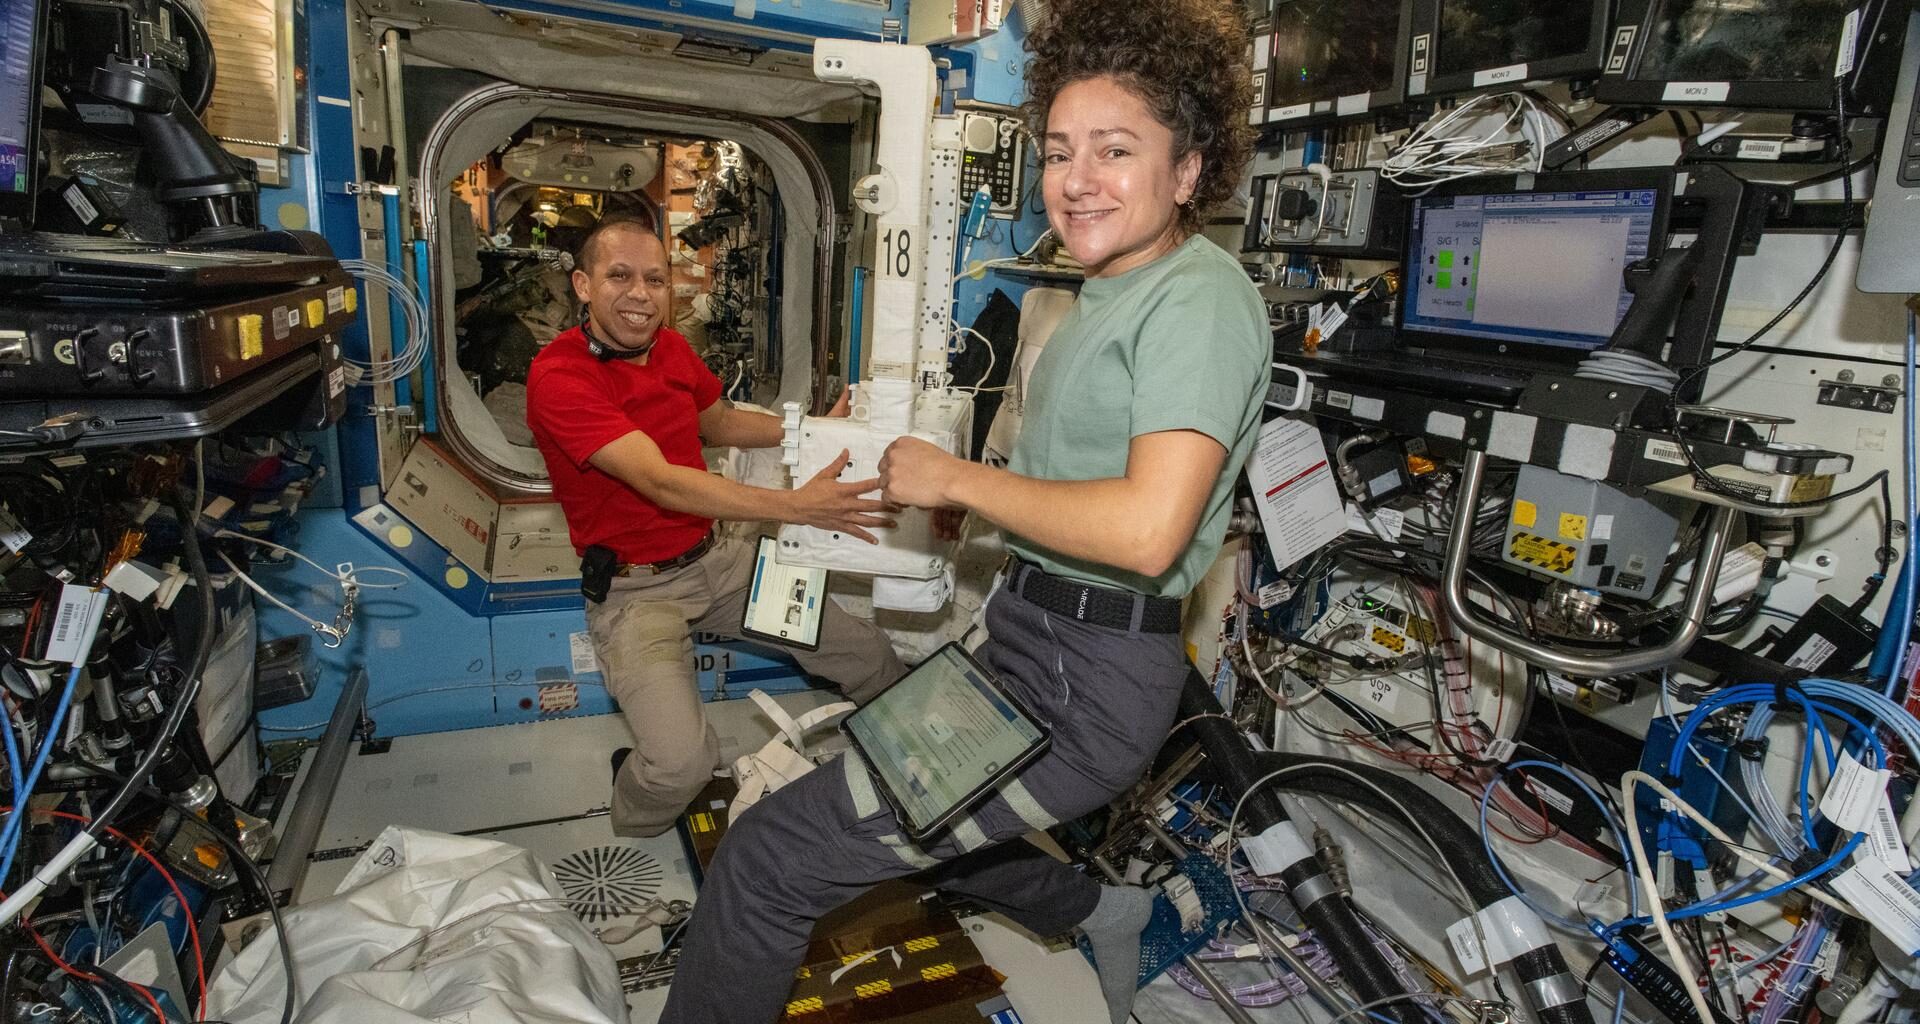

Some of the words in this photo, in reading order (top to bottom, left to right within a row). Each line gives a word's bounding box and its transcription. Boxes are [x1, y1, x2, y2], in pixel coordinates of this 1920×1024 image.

[0, 154, 16, 165] ASA
[883, 228, 910, 277] 18
[1524, 540, 1546, 549] CAUTION
[722, 652, 729, 669] 1
[1372, 691, 1383, 703] #7
